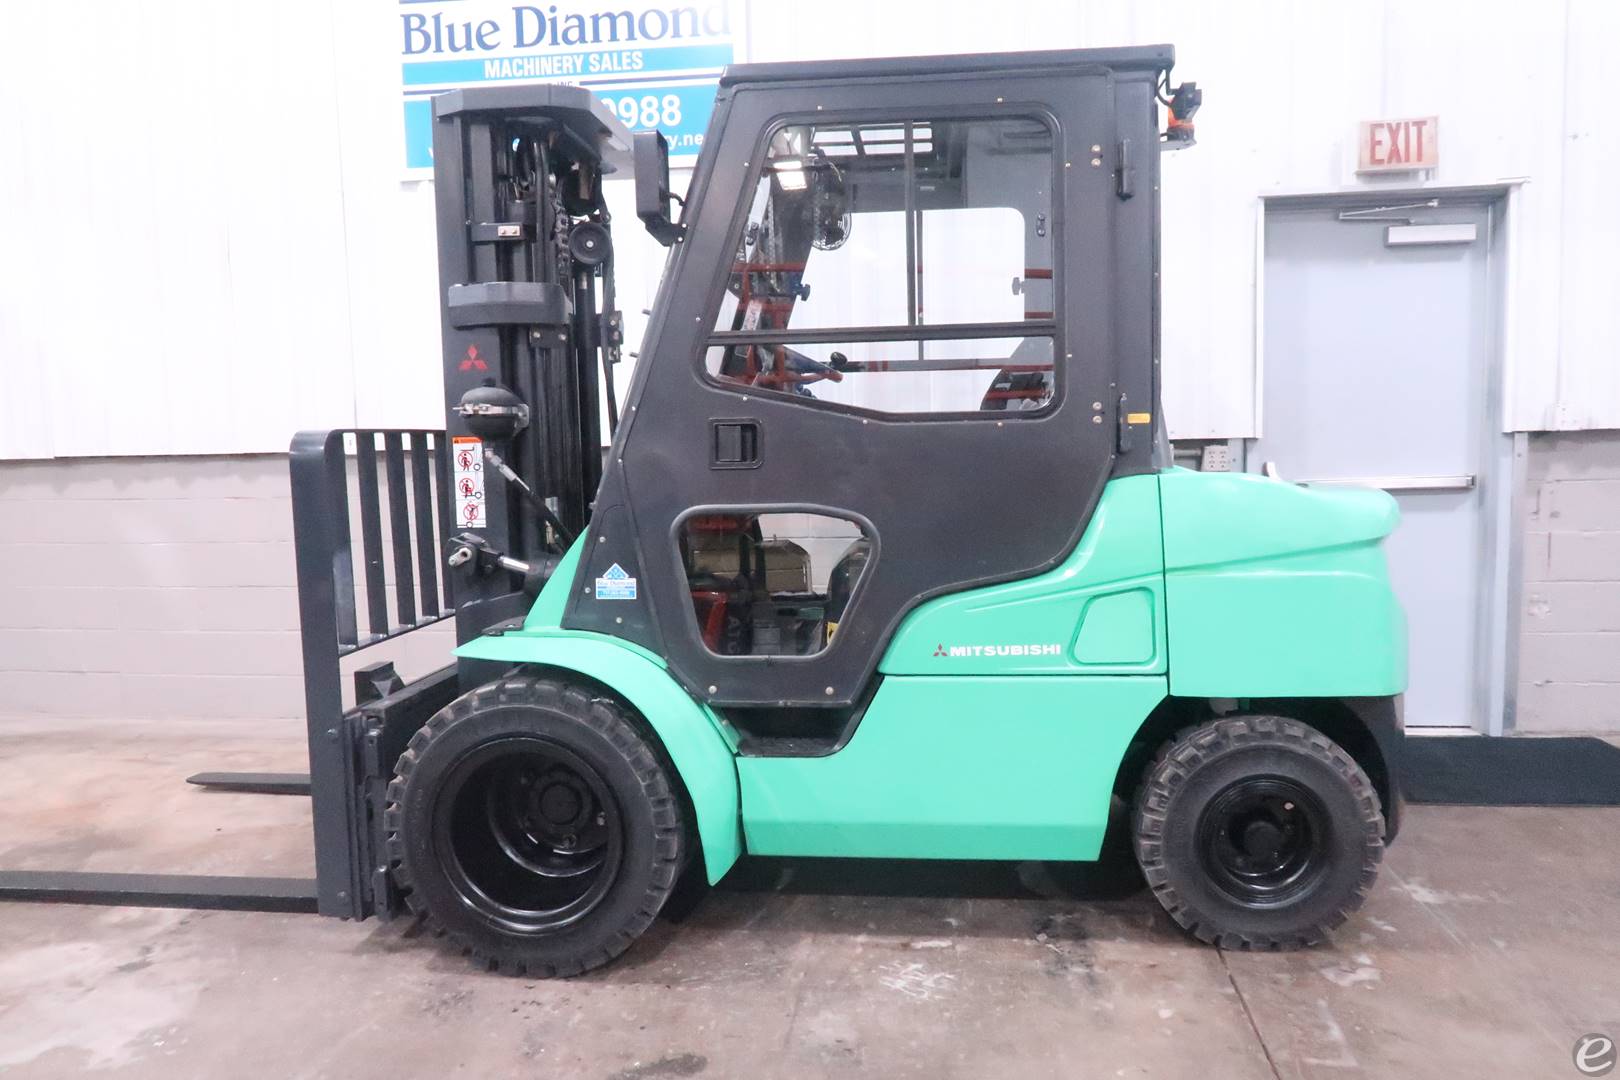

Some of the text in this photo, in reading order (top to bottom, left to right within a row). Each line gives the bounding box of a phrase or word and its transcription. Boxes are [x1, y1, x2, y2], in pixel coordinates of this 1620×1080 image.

[401, 0, 731, 55] Blue Diamond
[484, 51, 644, 79] MACHINERY SALES
[1369, 120, 1428, 165] EXIT
[950, 644, 1062, 657] MITSUBISHI
